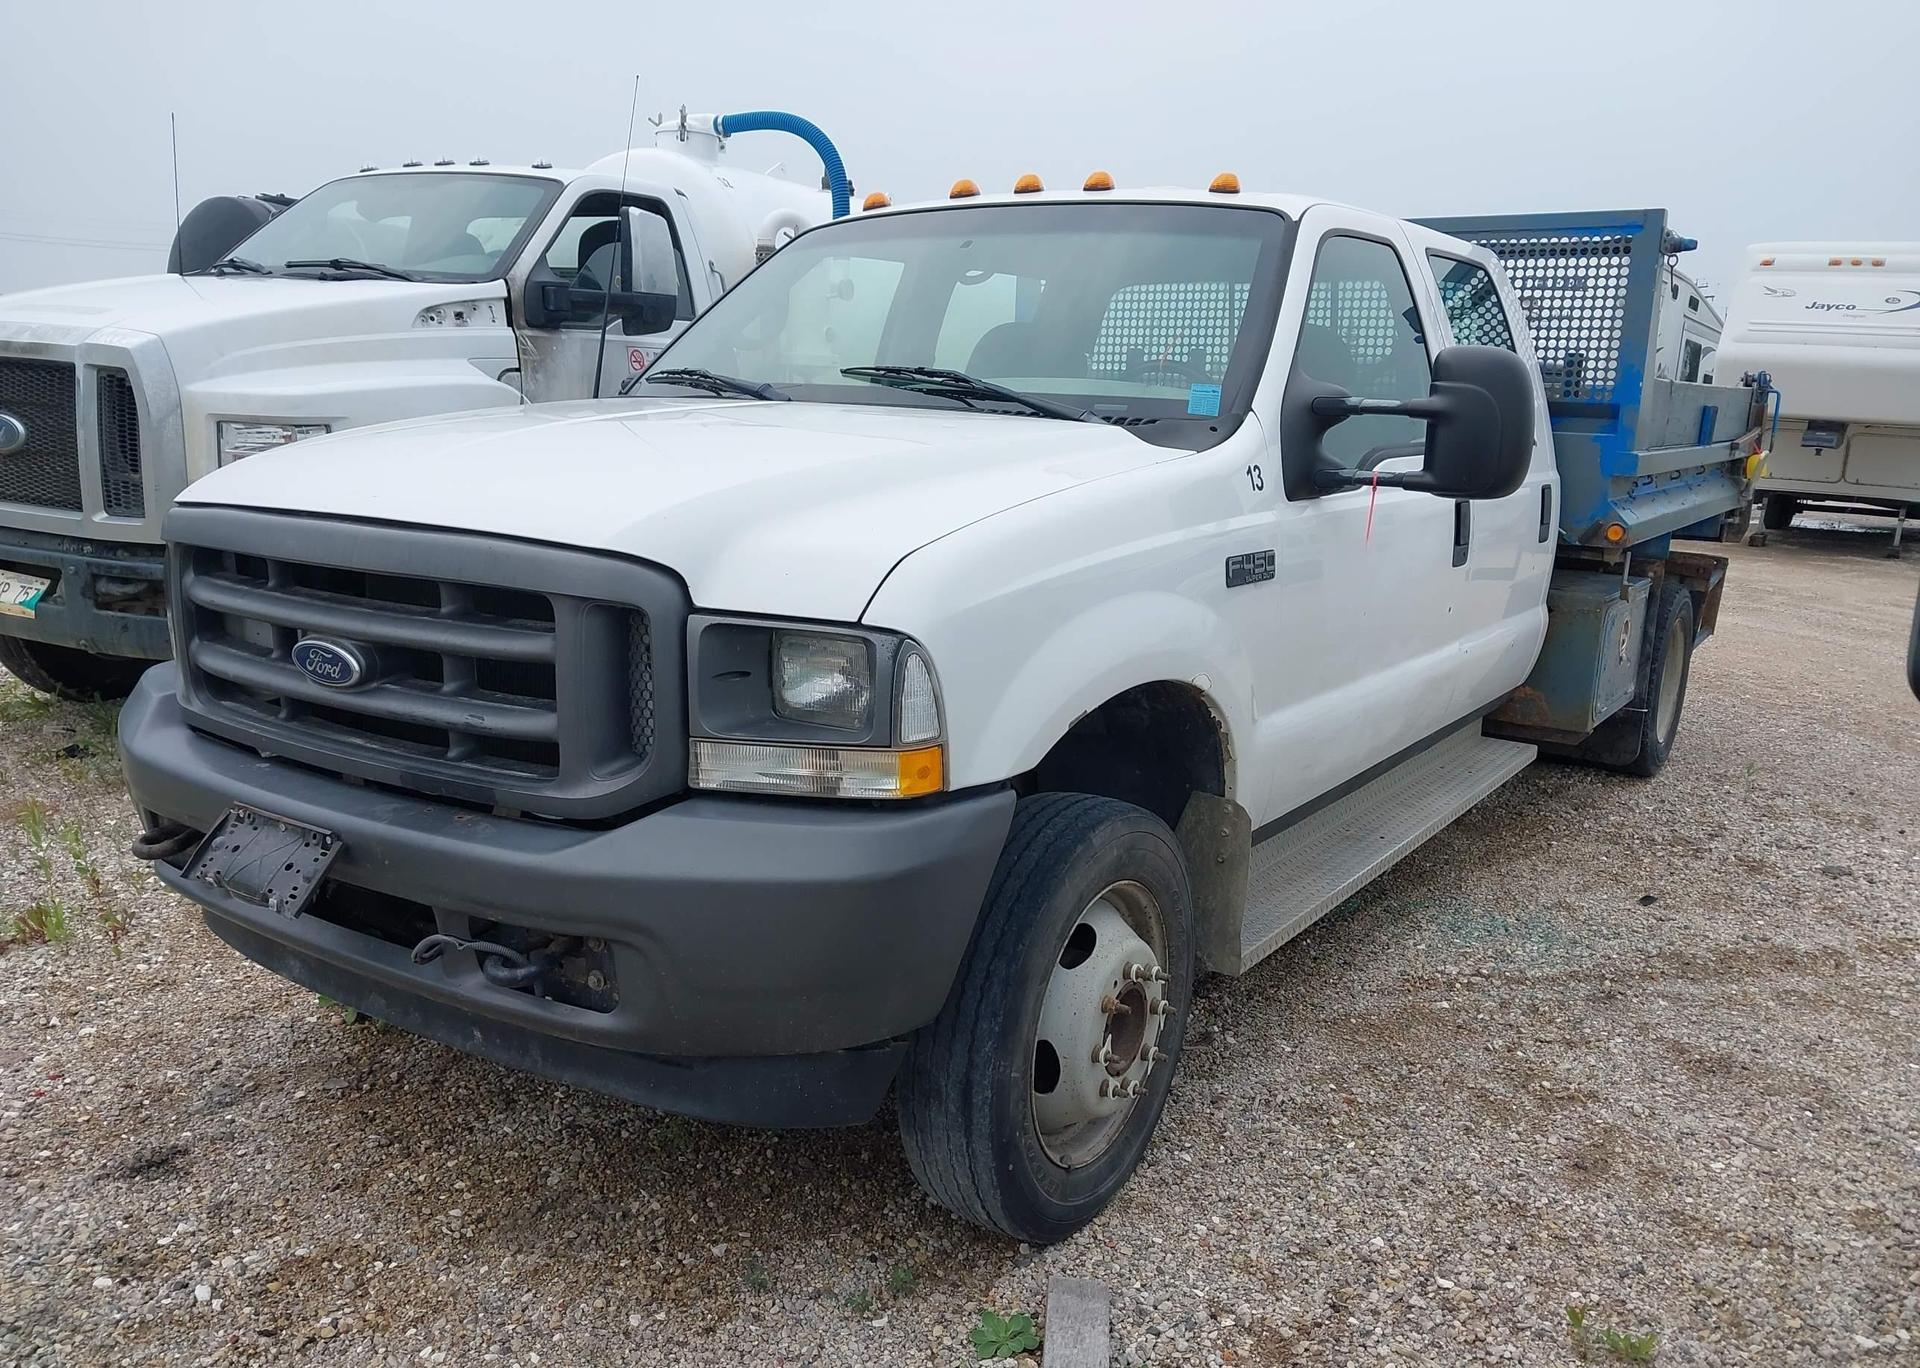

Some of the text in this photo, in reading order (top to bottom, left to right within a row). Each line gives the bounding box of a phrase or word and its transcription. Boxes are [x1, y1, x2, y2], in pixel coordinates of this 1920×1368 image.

[1804, 301, 1857, 312] Jayco
[1245, 464, 1264, 491] 13
[14, 585, 42, 604] 757
[306, 648, 342, 679] Ford
